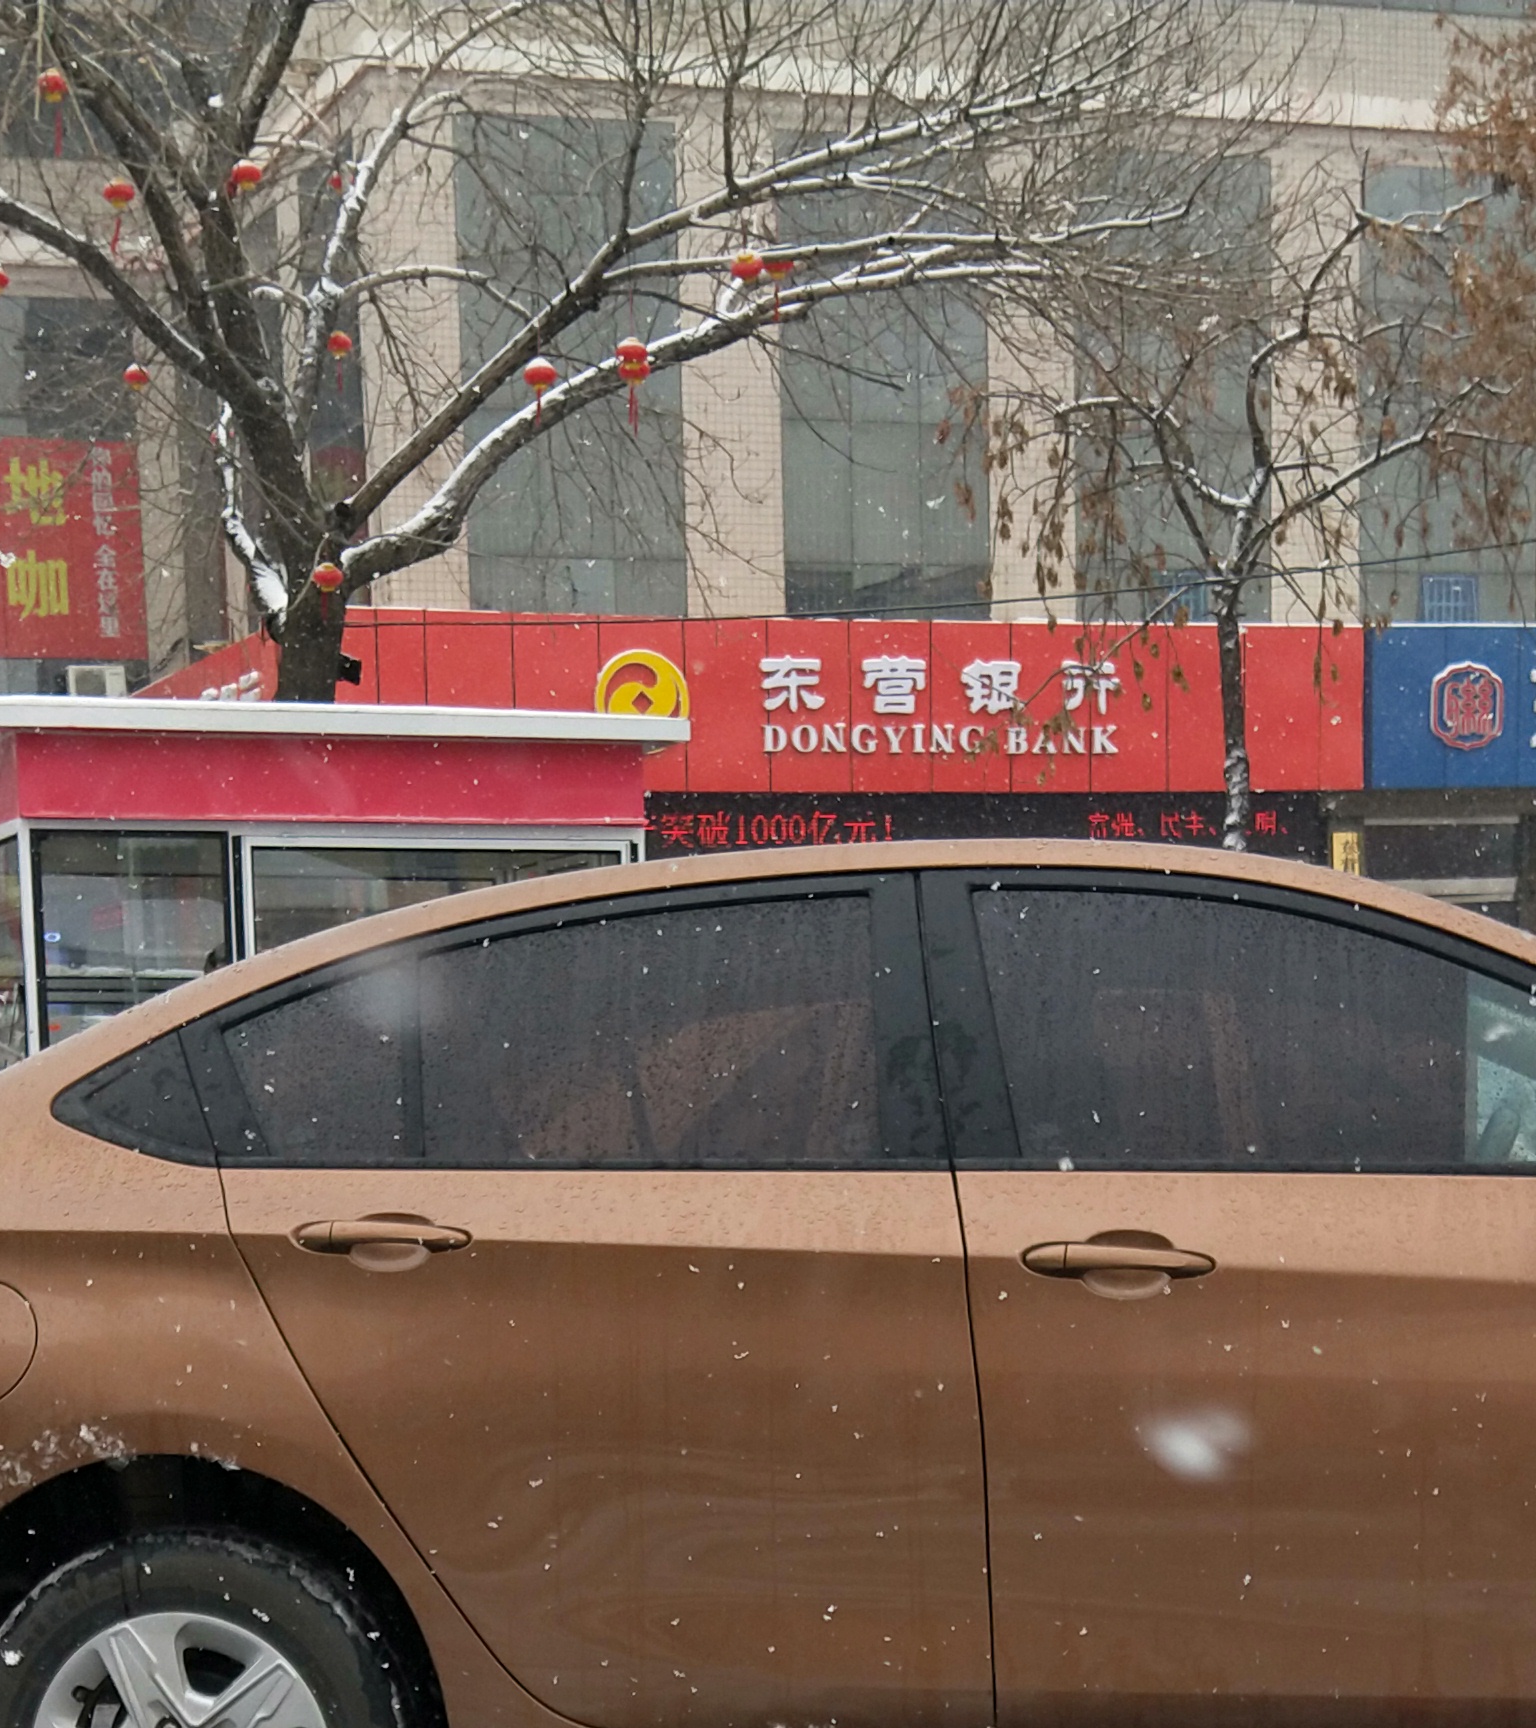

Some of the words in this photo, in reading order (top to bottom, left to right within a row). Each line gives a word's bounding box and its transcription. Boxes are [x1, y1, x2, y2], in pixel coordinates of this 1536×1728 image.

[759, 655, 1122, 715] 东营银行
[762, 722, 986, 755] DONGYING
[1006, 723, 1119, 755] BANK
